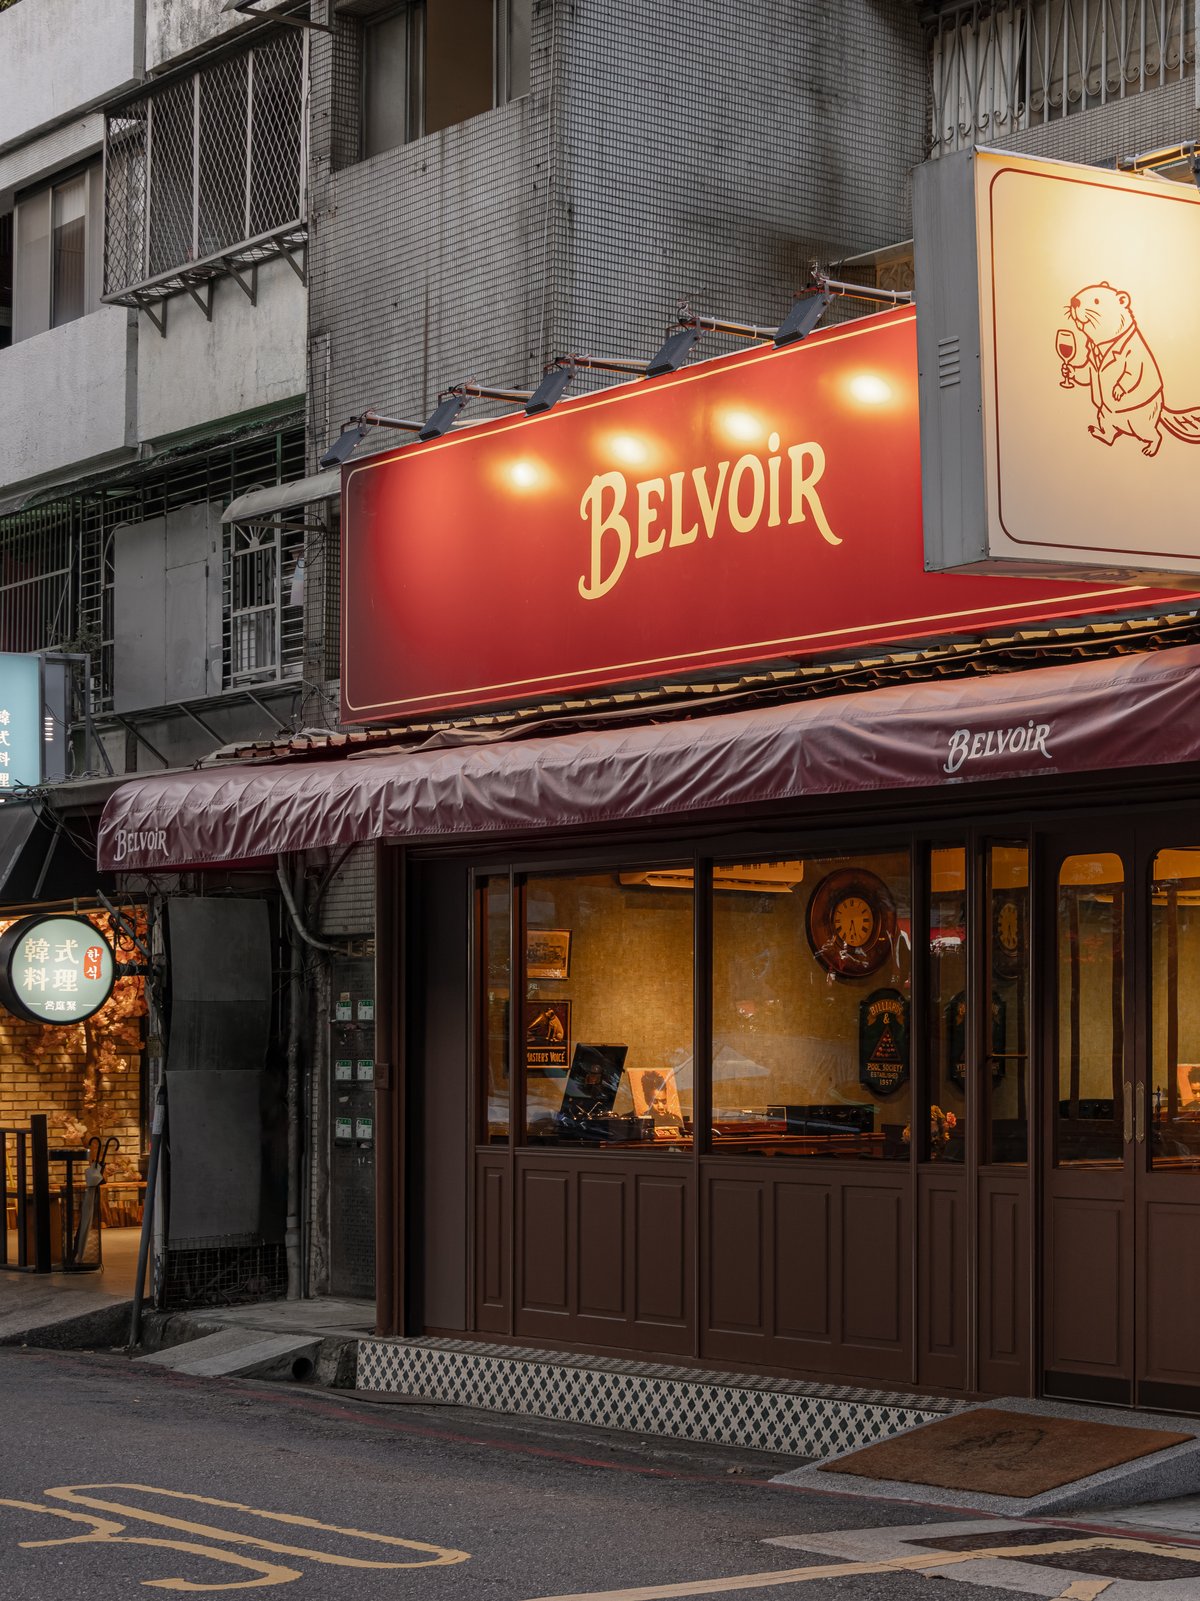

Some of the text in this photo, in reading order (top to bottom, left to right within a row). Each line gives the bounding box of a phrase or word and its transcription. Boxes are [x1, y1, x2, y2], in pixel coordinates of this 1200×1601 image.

[24, 938, 80, 965] 韓式
[86, 948, 100, 980] 한식
[23, 966, 79, 992] 料理
[882, 1012, 890, 1025] &
